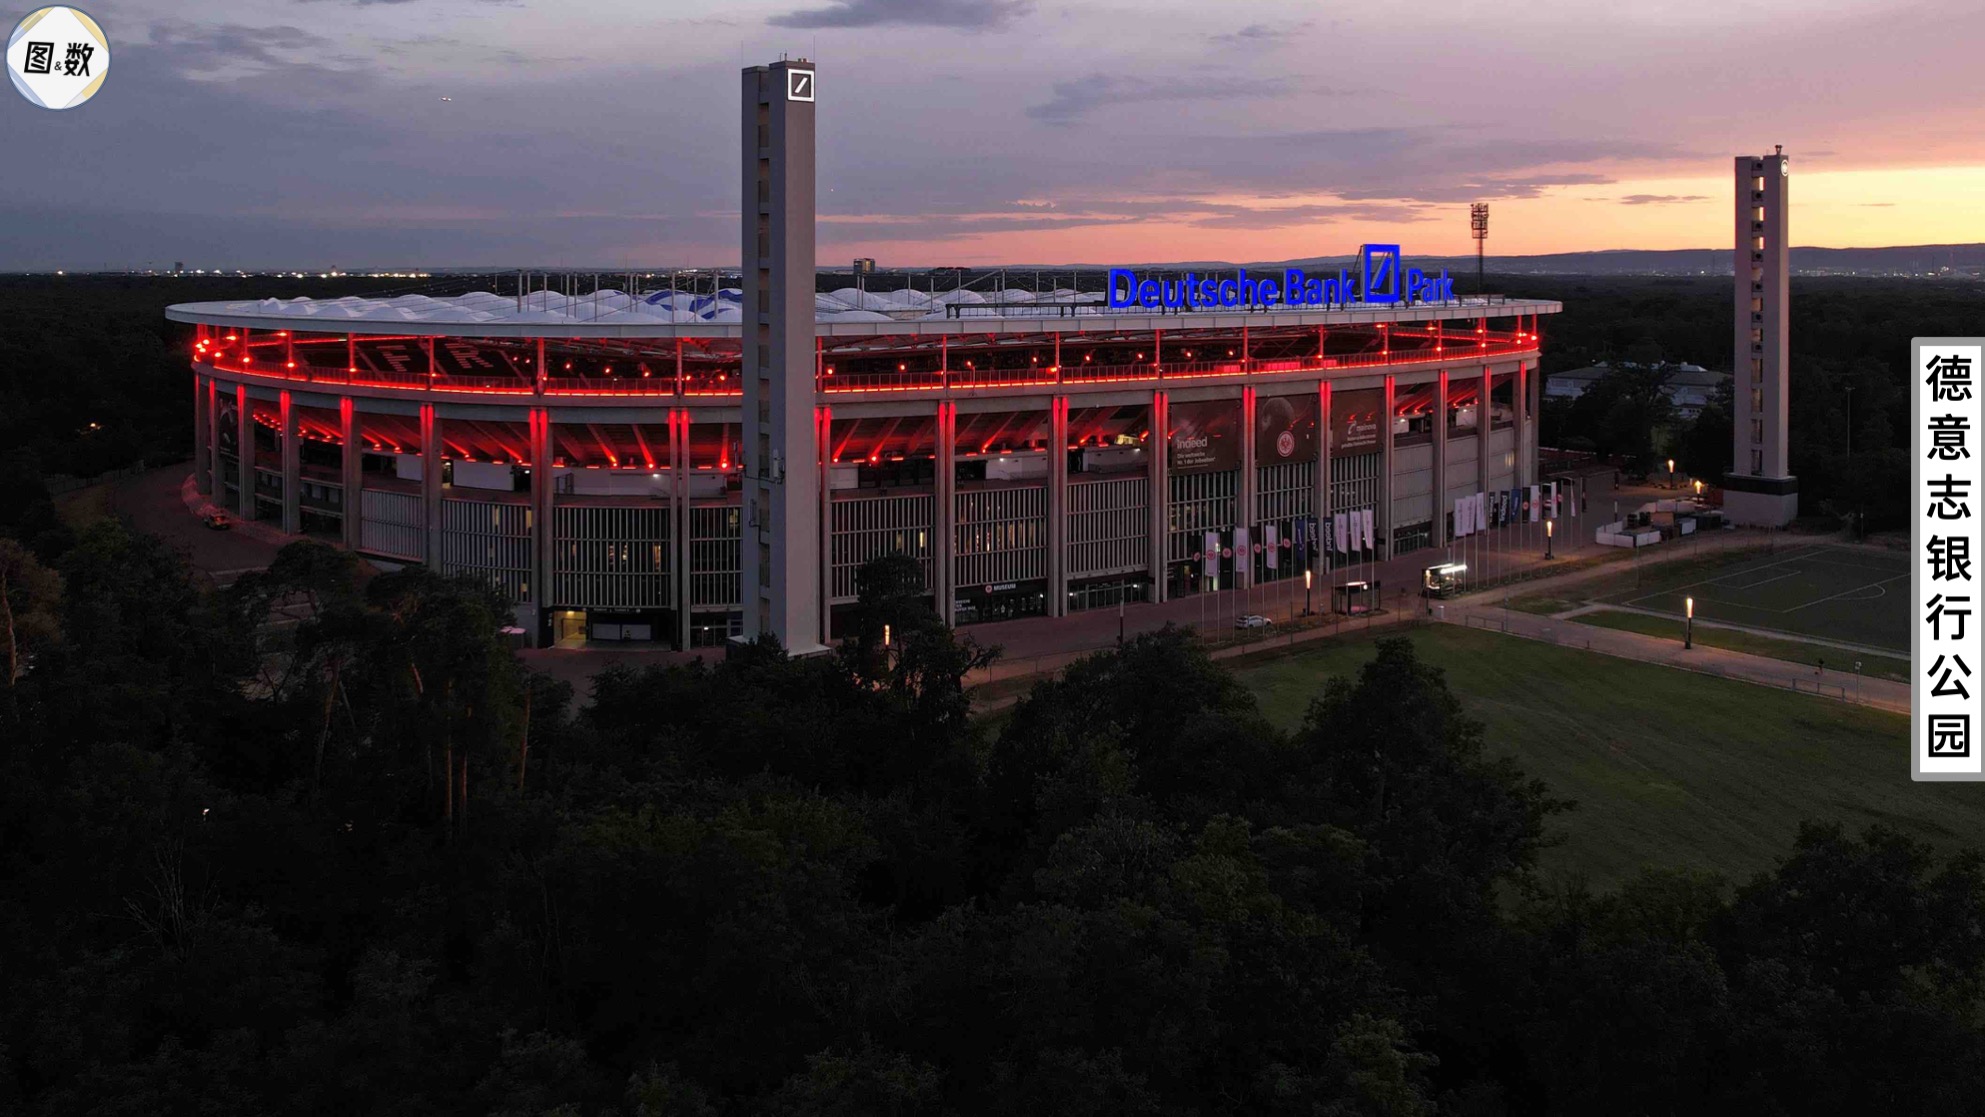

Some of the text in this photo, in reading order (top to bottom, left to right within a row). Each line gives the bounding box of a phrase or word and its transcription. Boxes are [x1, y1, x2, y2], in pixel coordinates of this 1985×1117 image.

[1108, 267, 1454, 309] Deutsche Bank Park
[1177, 436, 1208, 449] indeed
[994, 583, 1016, 592] MUSEUM
